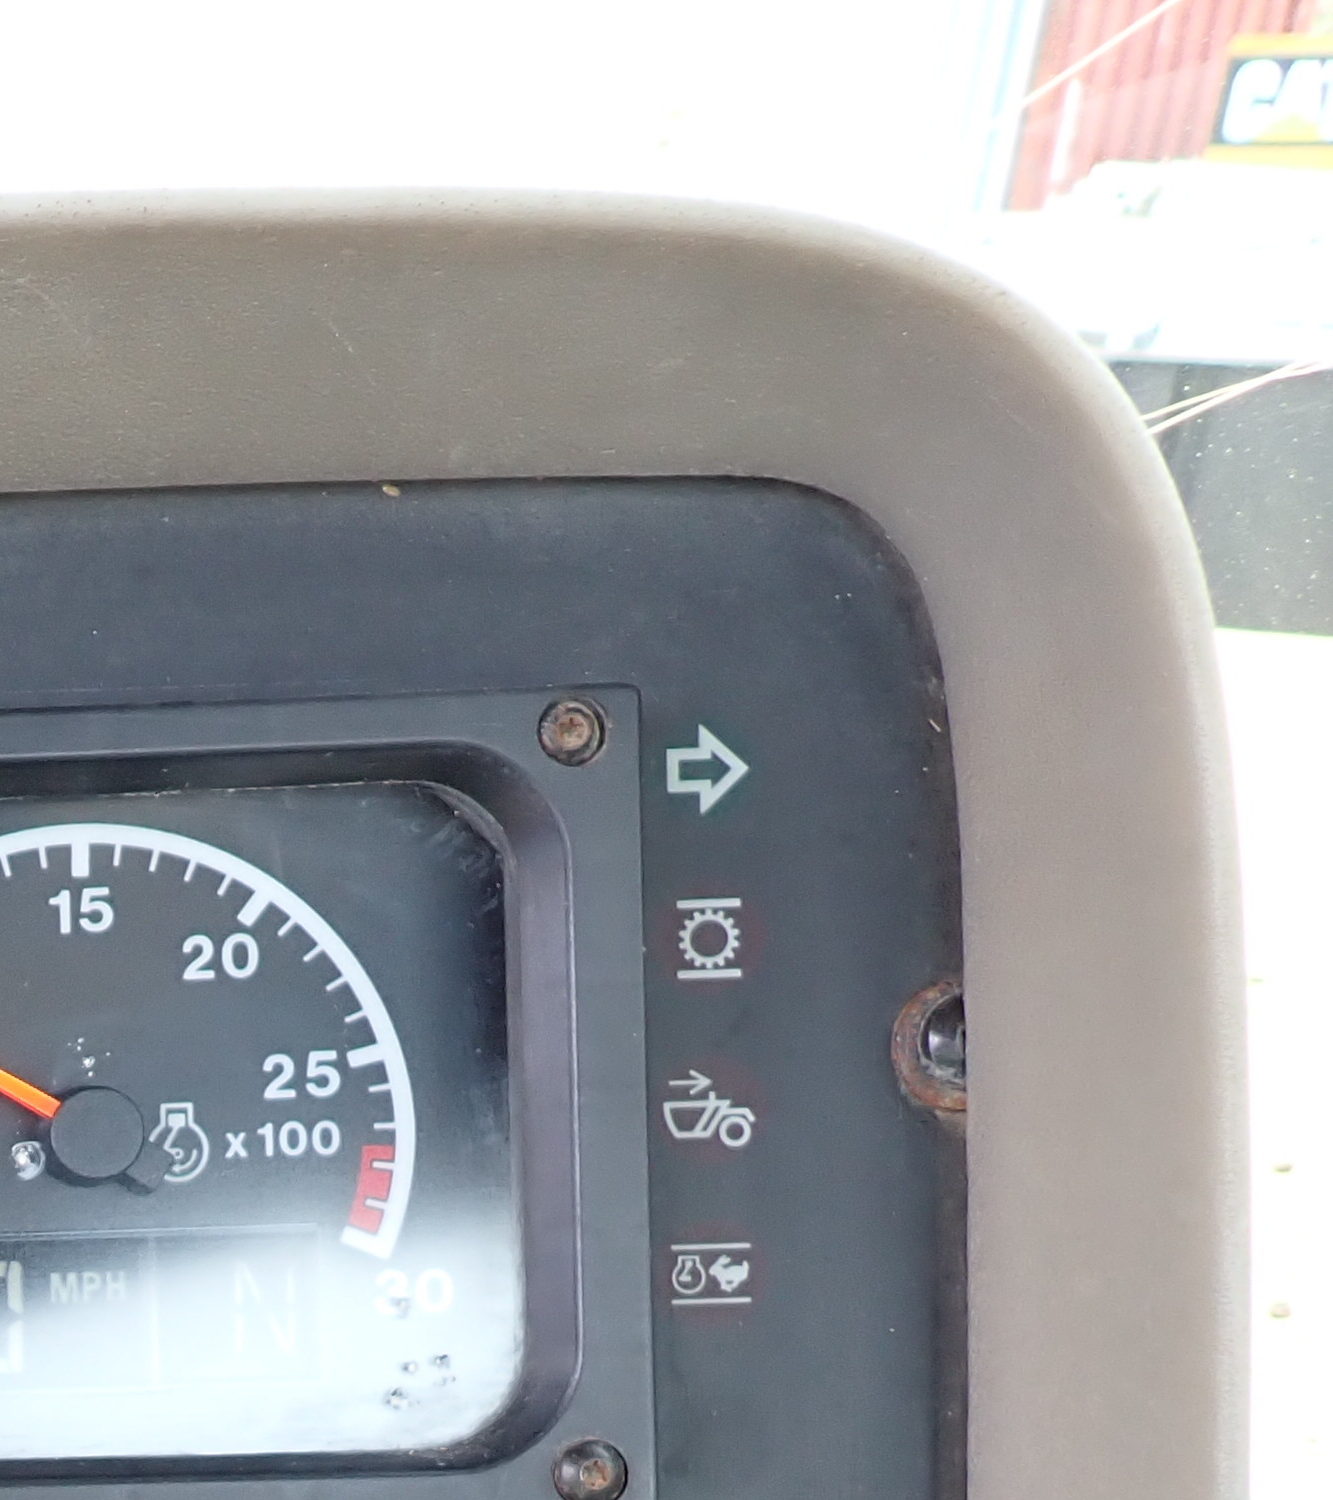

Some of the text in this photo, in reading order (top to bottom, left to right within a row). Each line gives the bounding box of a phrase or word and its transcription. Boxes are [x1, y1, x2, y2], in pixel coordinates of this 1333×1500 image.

[1221, 58, 1333, 144] CA
[49, 886, 114, 934] 15
[181, 933, 260, 981] 20
[262, 1053, 342, 1100] 25
[49, 1270, 129, 1304] MPH
[376, 1268, 455, 1314] 30
